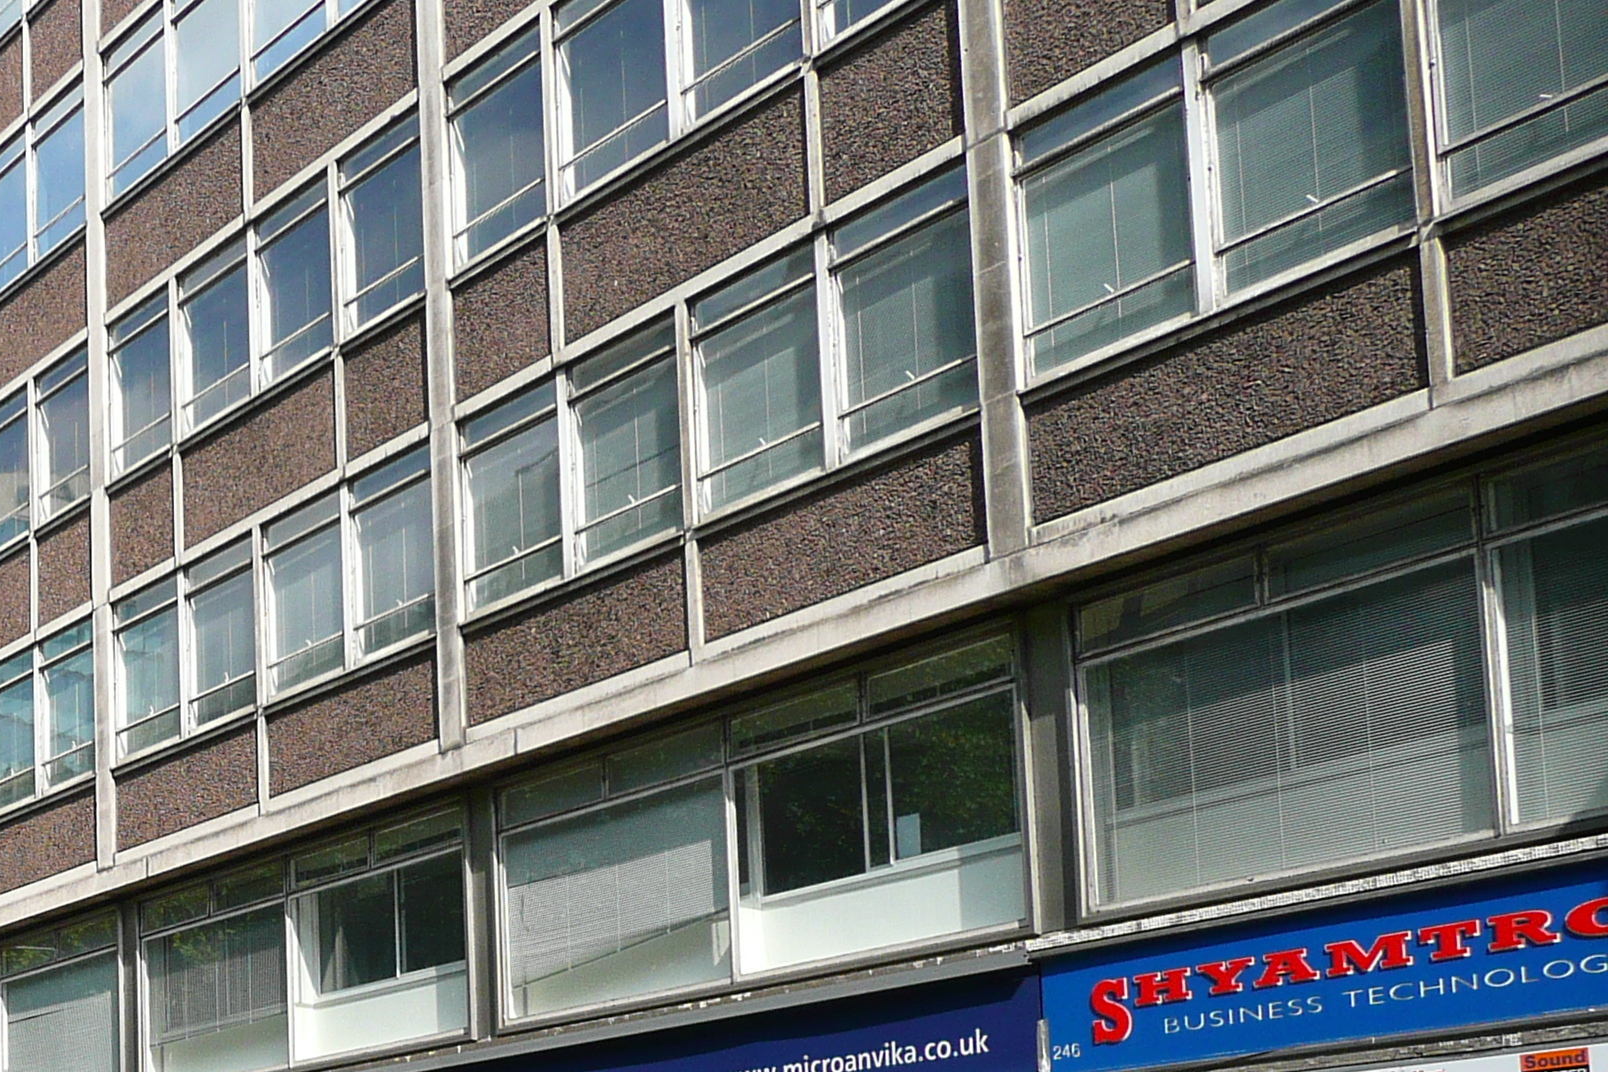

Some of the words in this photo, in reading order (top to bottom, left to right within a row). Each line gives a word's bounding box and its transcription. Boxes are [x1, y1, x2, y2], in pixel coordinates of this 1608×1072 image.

[1164, 996, 1322, 1034] BUSINESS
[1053, 1043, 1080, 1059] 246
[1523, 1050, 1587, 1069] Sound
